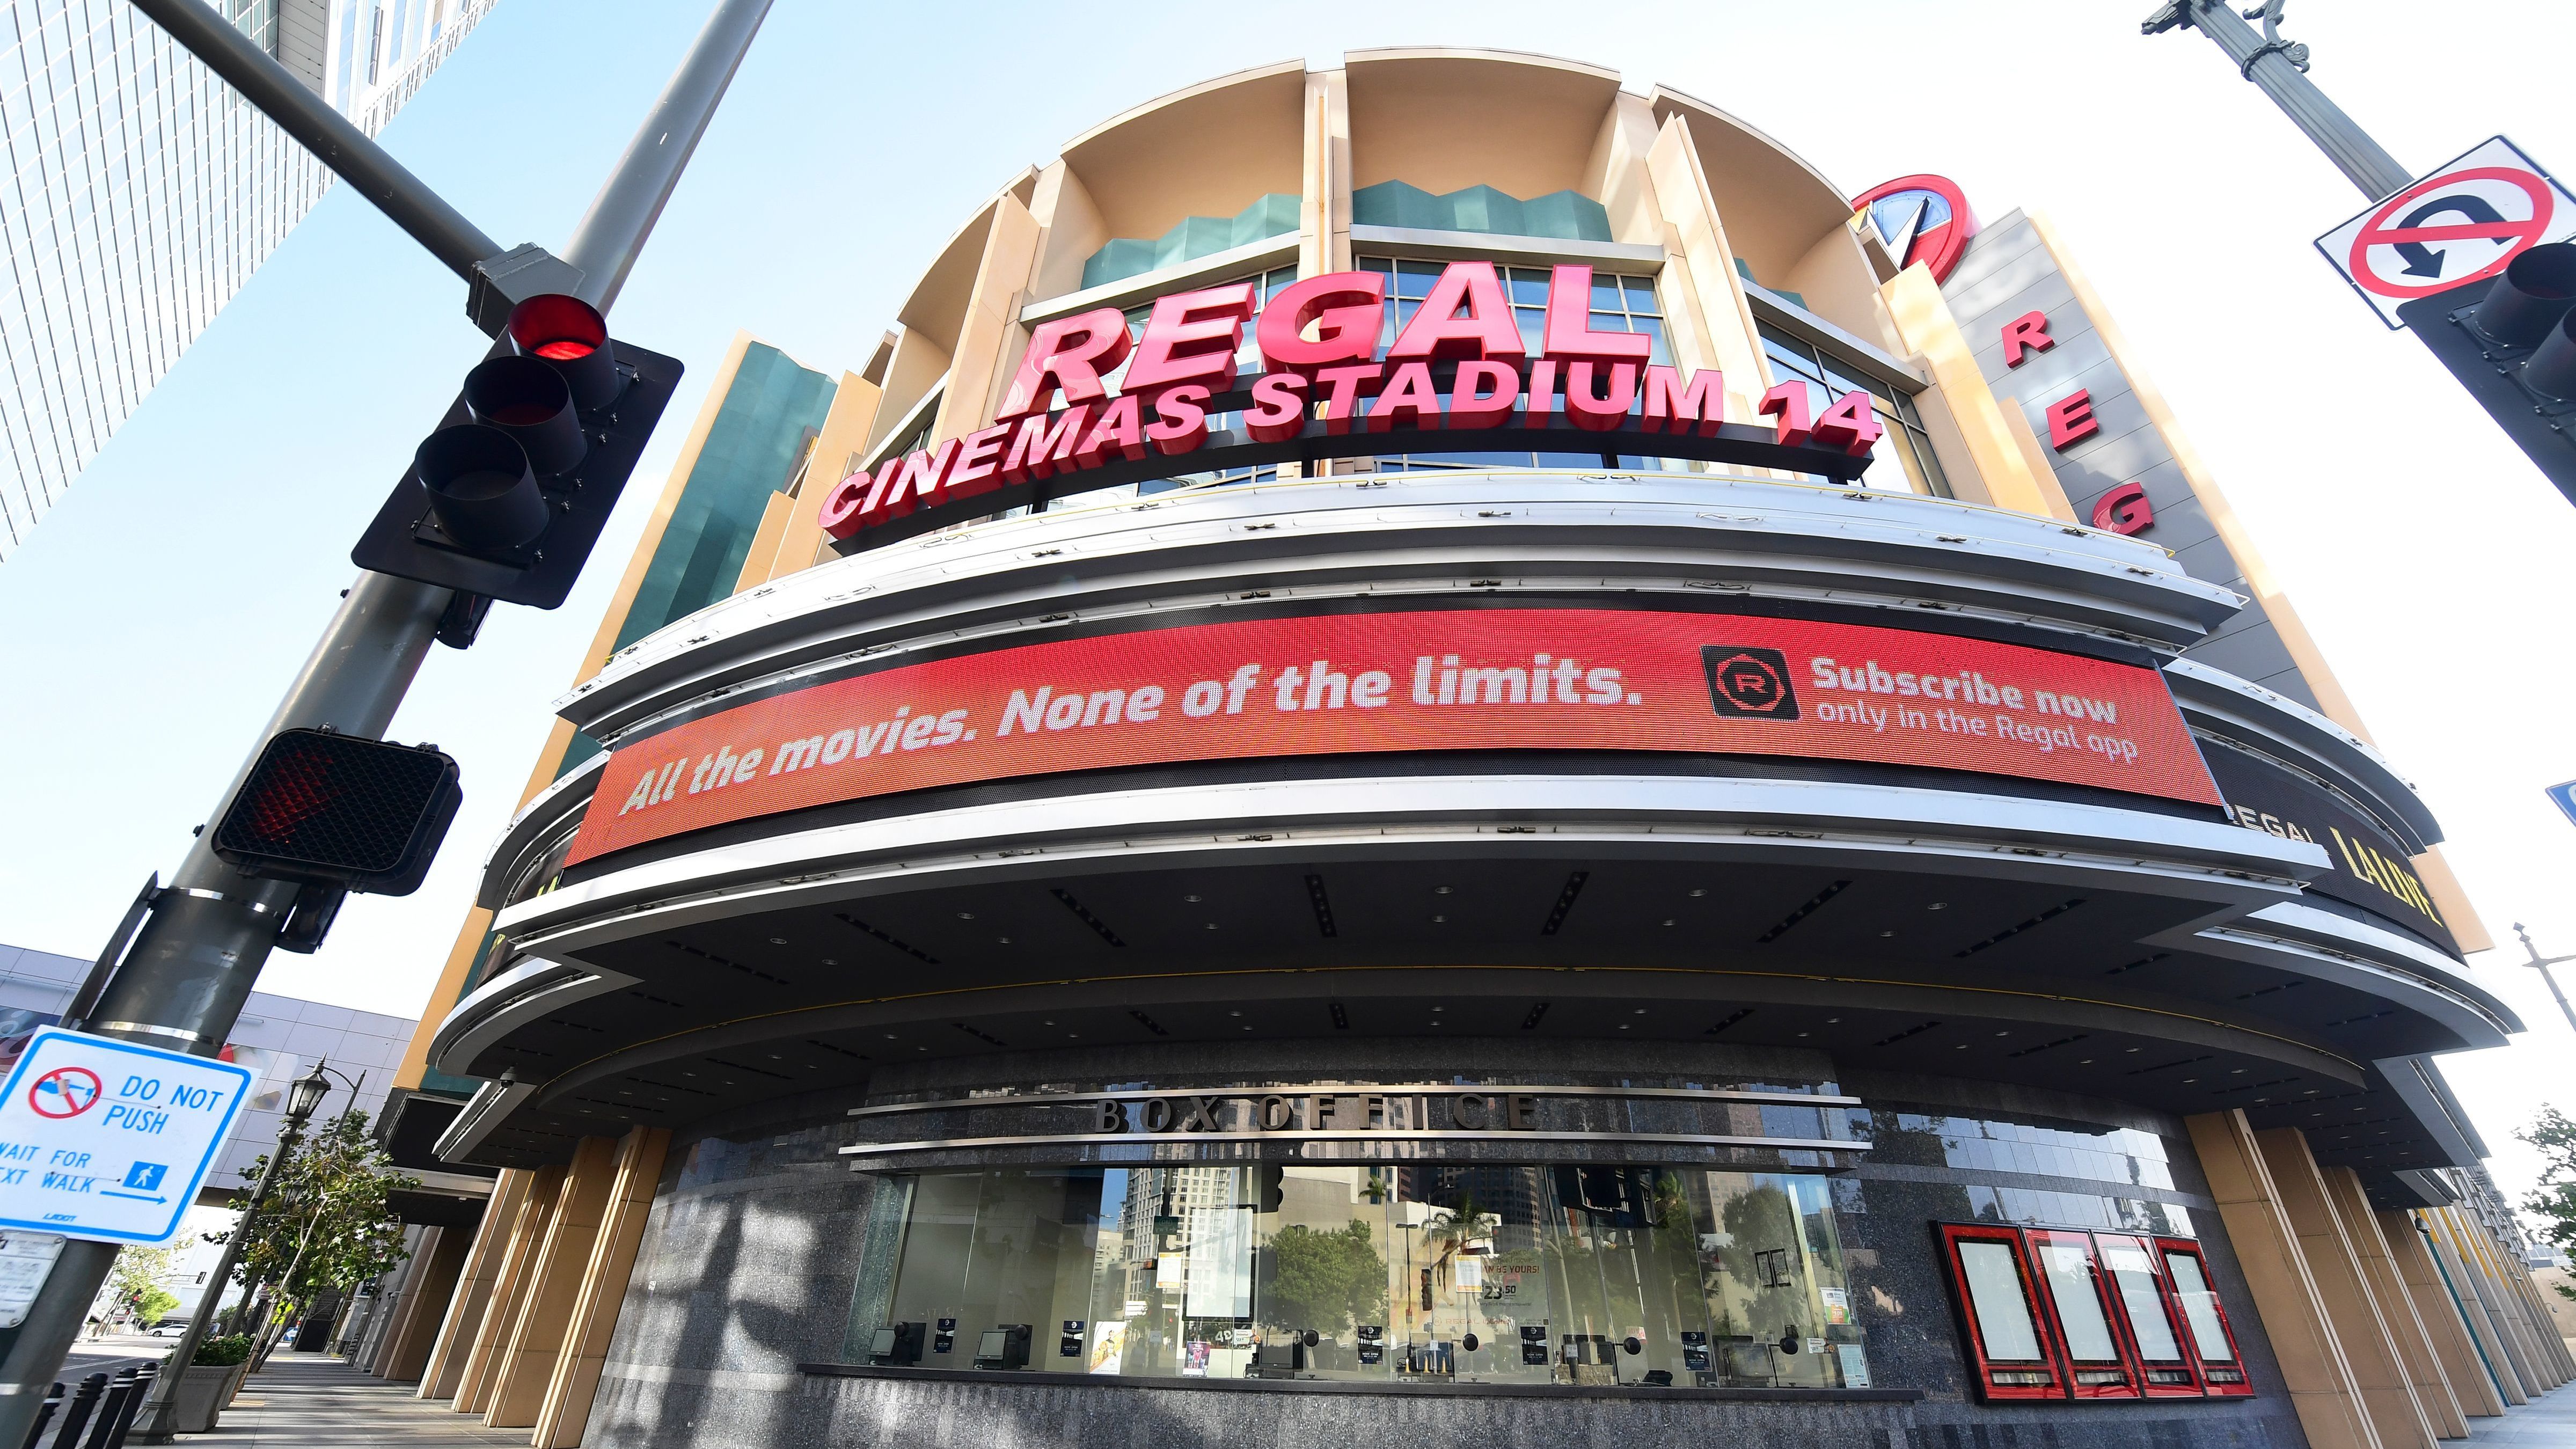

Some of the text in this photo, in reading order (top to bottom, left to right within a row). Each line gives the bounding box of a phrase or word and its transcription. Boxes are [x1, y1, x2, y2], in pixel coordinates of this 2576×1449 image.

[995, 261, 1651, 424] REGAL
[818, 360, 1883, 539] CINEMAS STADIUM 14
[1811, 657, 2118, 726] Subscribe now
[619, 653, 1641, 816] All the movies. None of the limits.
[1818, 699, 2139, 765] only in the Regal app
[119, 1075, 224, 1112] DO NOT
[1095, 1093, 1536, 1132] BOX OFFICE
[102, 1104, 170, 1135] PUSH
[49, 1150, 92, 1168] FOR
[41, 1173, 97, 1193] WALK
[1509, 1265, 1540, 1274] YOURS!
